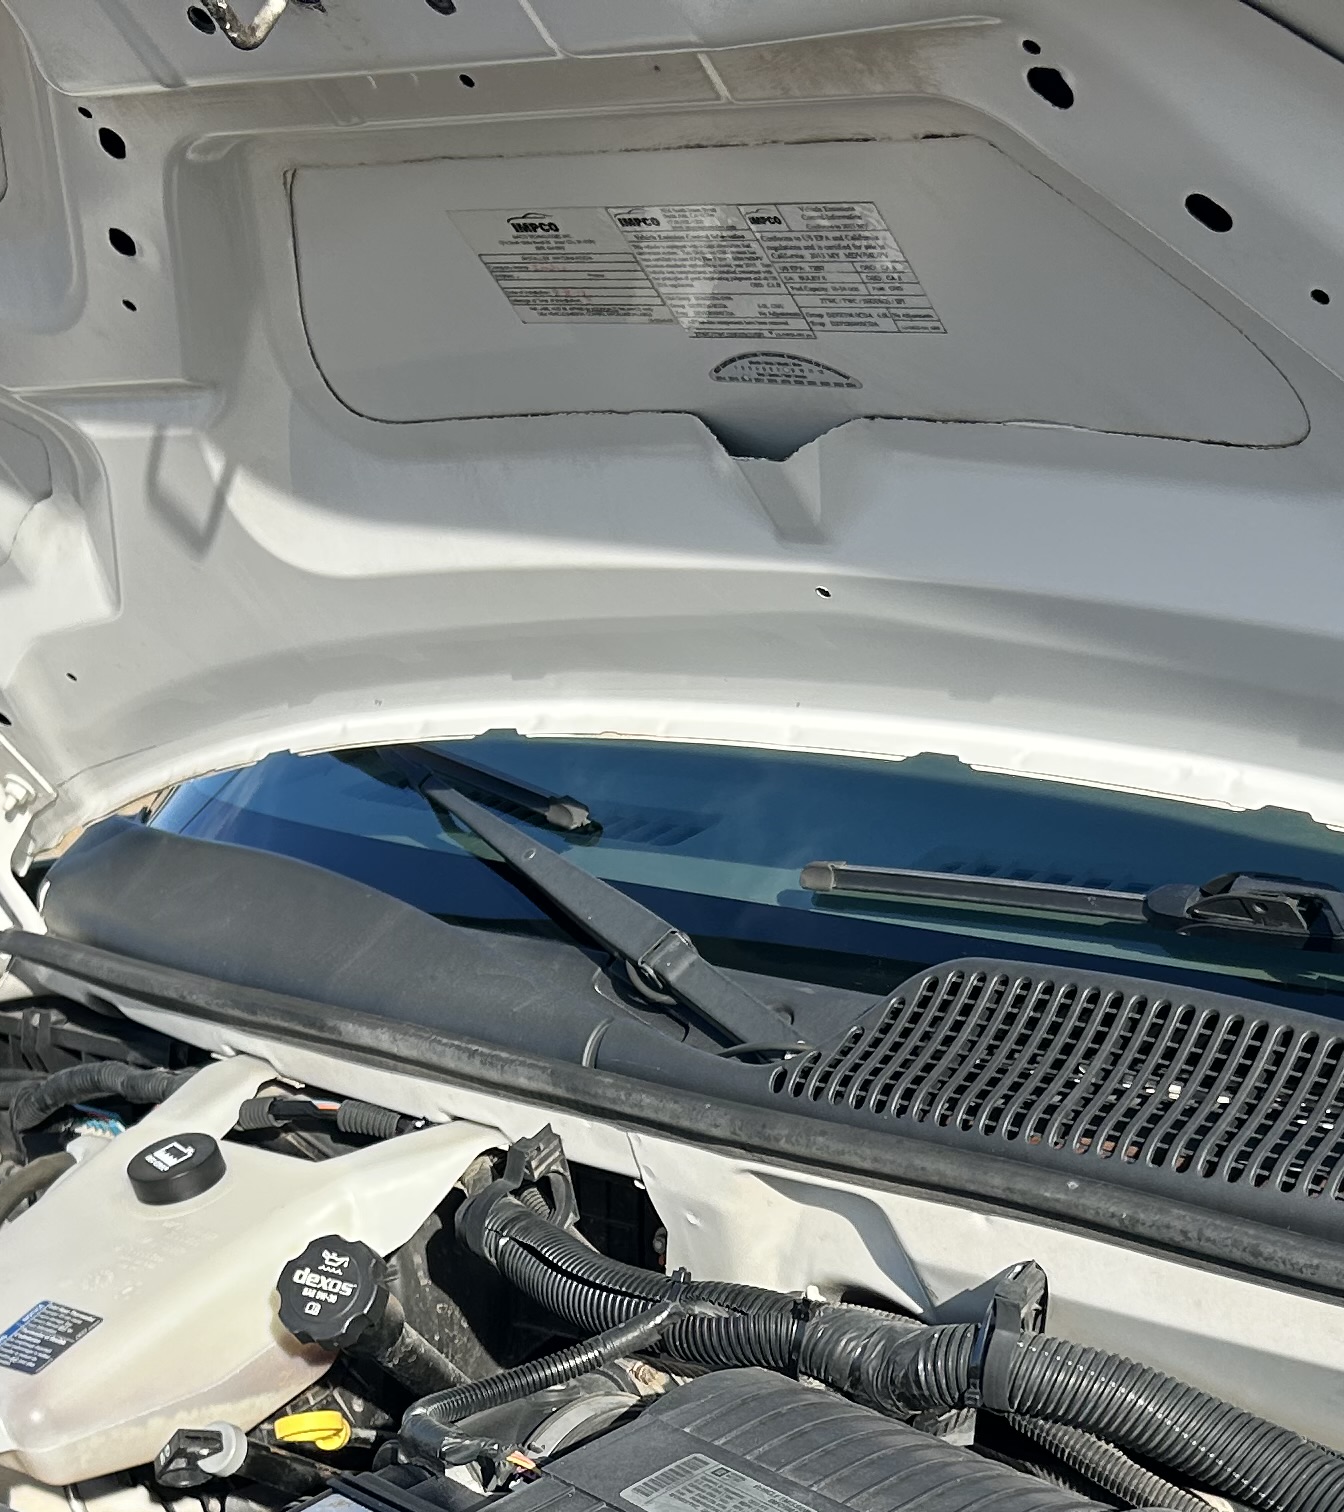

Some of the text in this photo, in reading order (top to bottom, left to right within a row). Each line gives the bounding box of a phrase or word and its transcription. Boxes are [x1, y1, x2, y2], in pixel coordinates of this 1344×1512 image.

[617, 217, 661, 227] IMPCO
[748, 216, 782, 225] IMPCO
[510, 222, 560, 233] IMPCO
[292, 1267, 355, 1297] dexos
